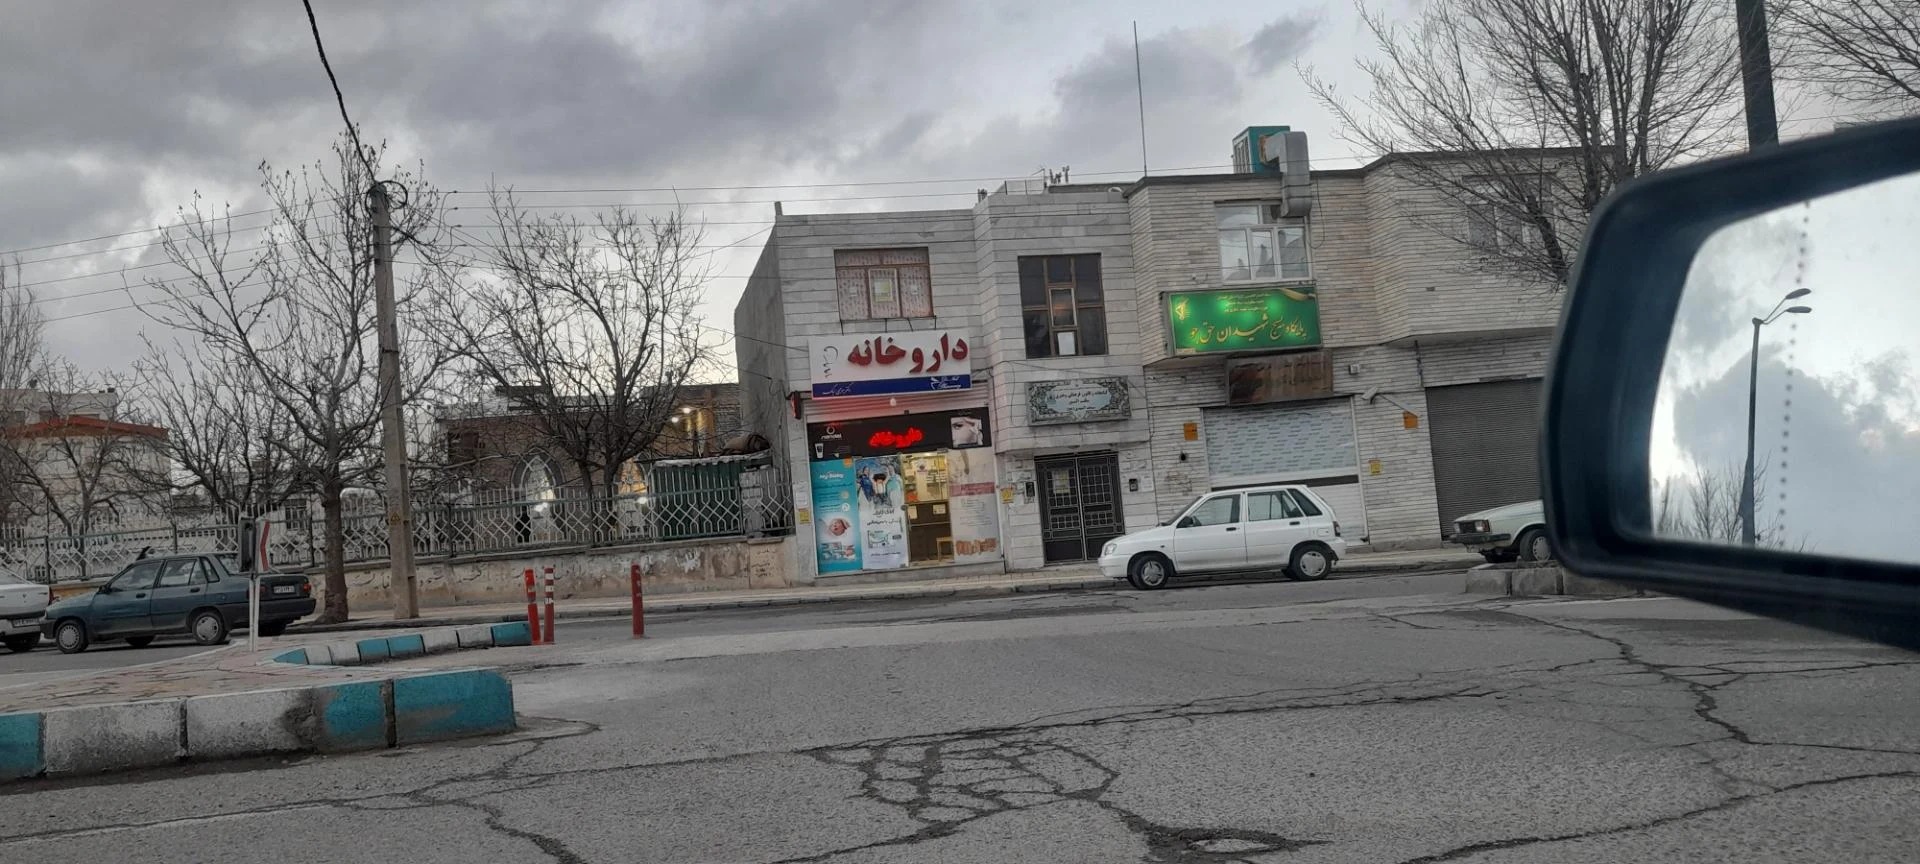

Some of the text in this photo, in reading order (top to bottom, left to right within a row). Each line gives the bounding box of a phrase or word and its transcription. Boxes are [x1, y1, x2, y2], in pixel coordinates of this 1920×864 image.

[1199, 321, 1215, 344] حق
[1216, 312, 1269, 342] شهیدان
[1269, 315, 1285, 340] بسیج
[847, 332, 969, 374] داروخانه
[868, 427, 923, 449] داروخانه
